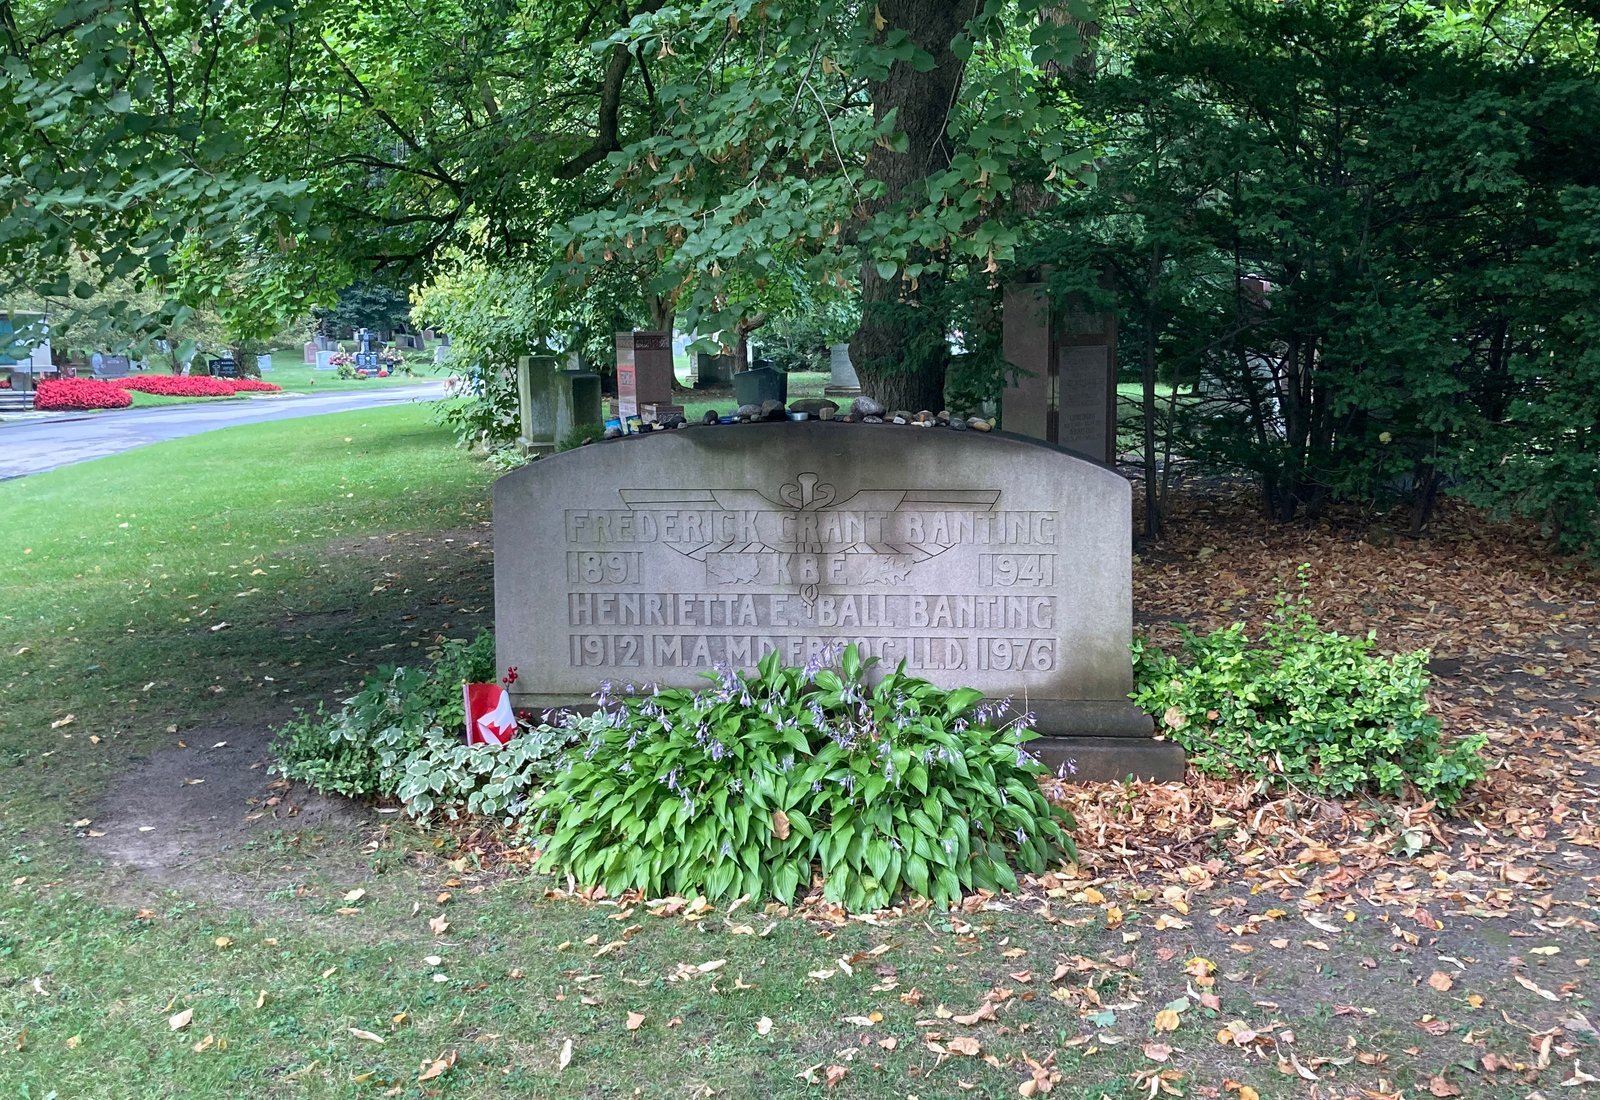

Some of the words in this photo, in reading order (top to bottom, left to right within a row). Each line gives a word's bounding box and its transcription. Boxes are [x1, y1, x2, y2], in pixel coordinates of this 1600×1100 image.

[571, 510, 760, 543] FREDERICK
[778, 511, 888, 544] GRANT
[905, 511, 1055, 545] BANTING
[570, 552, 641, 584] 1891
[984, 554, 1055, 587] 1941
[571, 594, 759, 627] HENRIETTA
[769, 594, 799, 628] E.
[817, 594, 895, 628] BALL
[908, 595, 1054, 629] BANTING
[570, 635, 642, 667] 1912
[980, 638, 1055, 671] 1976
